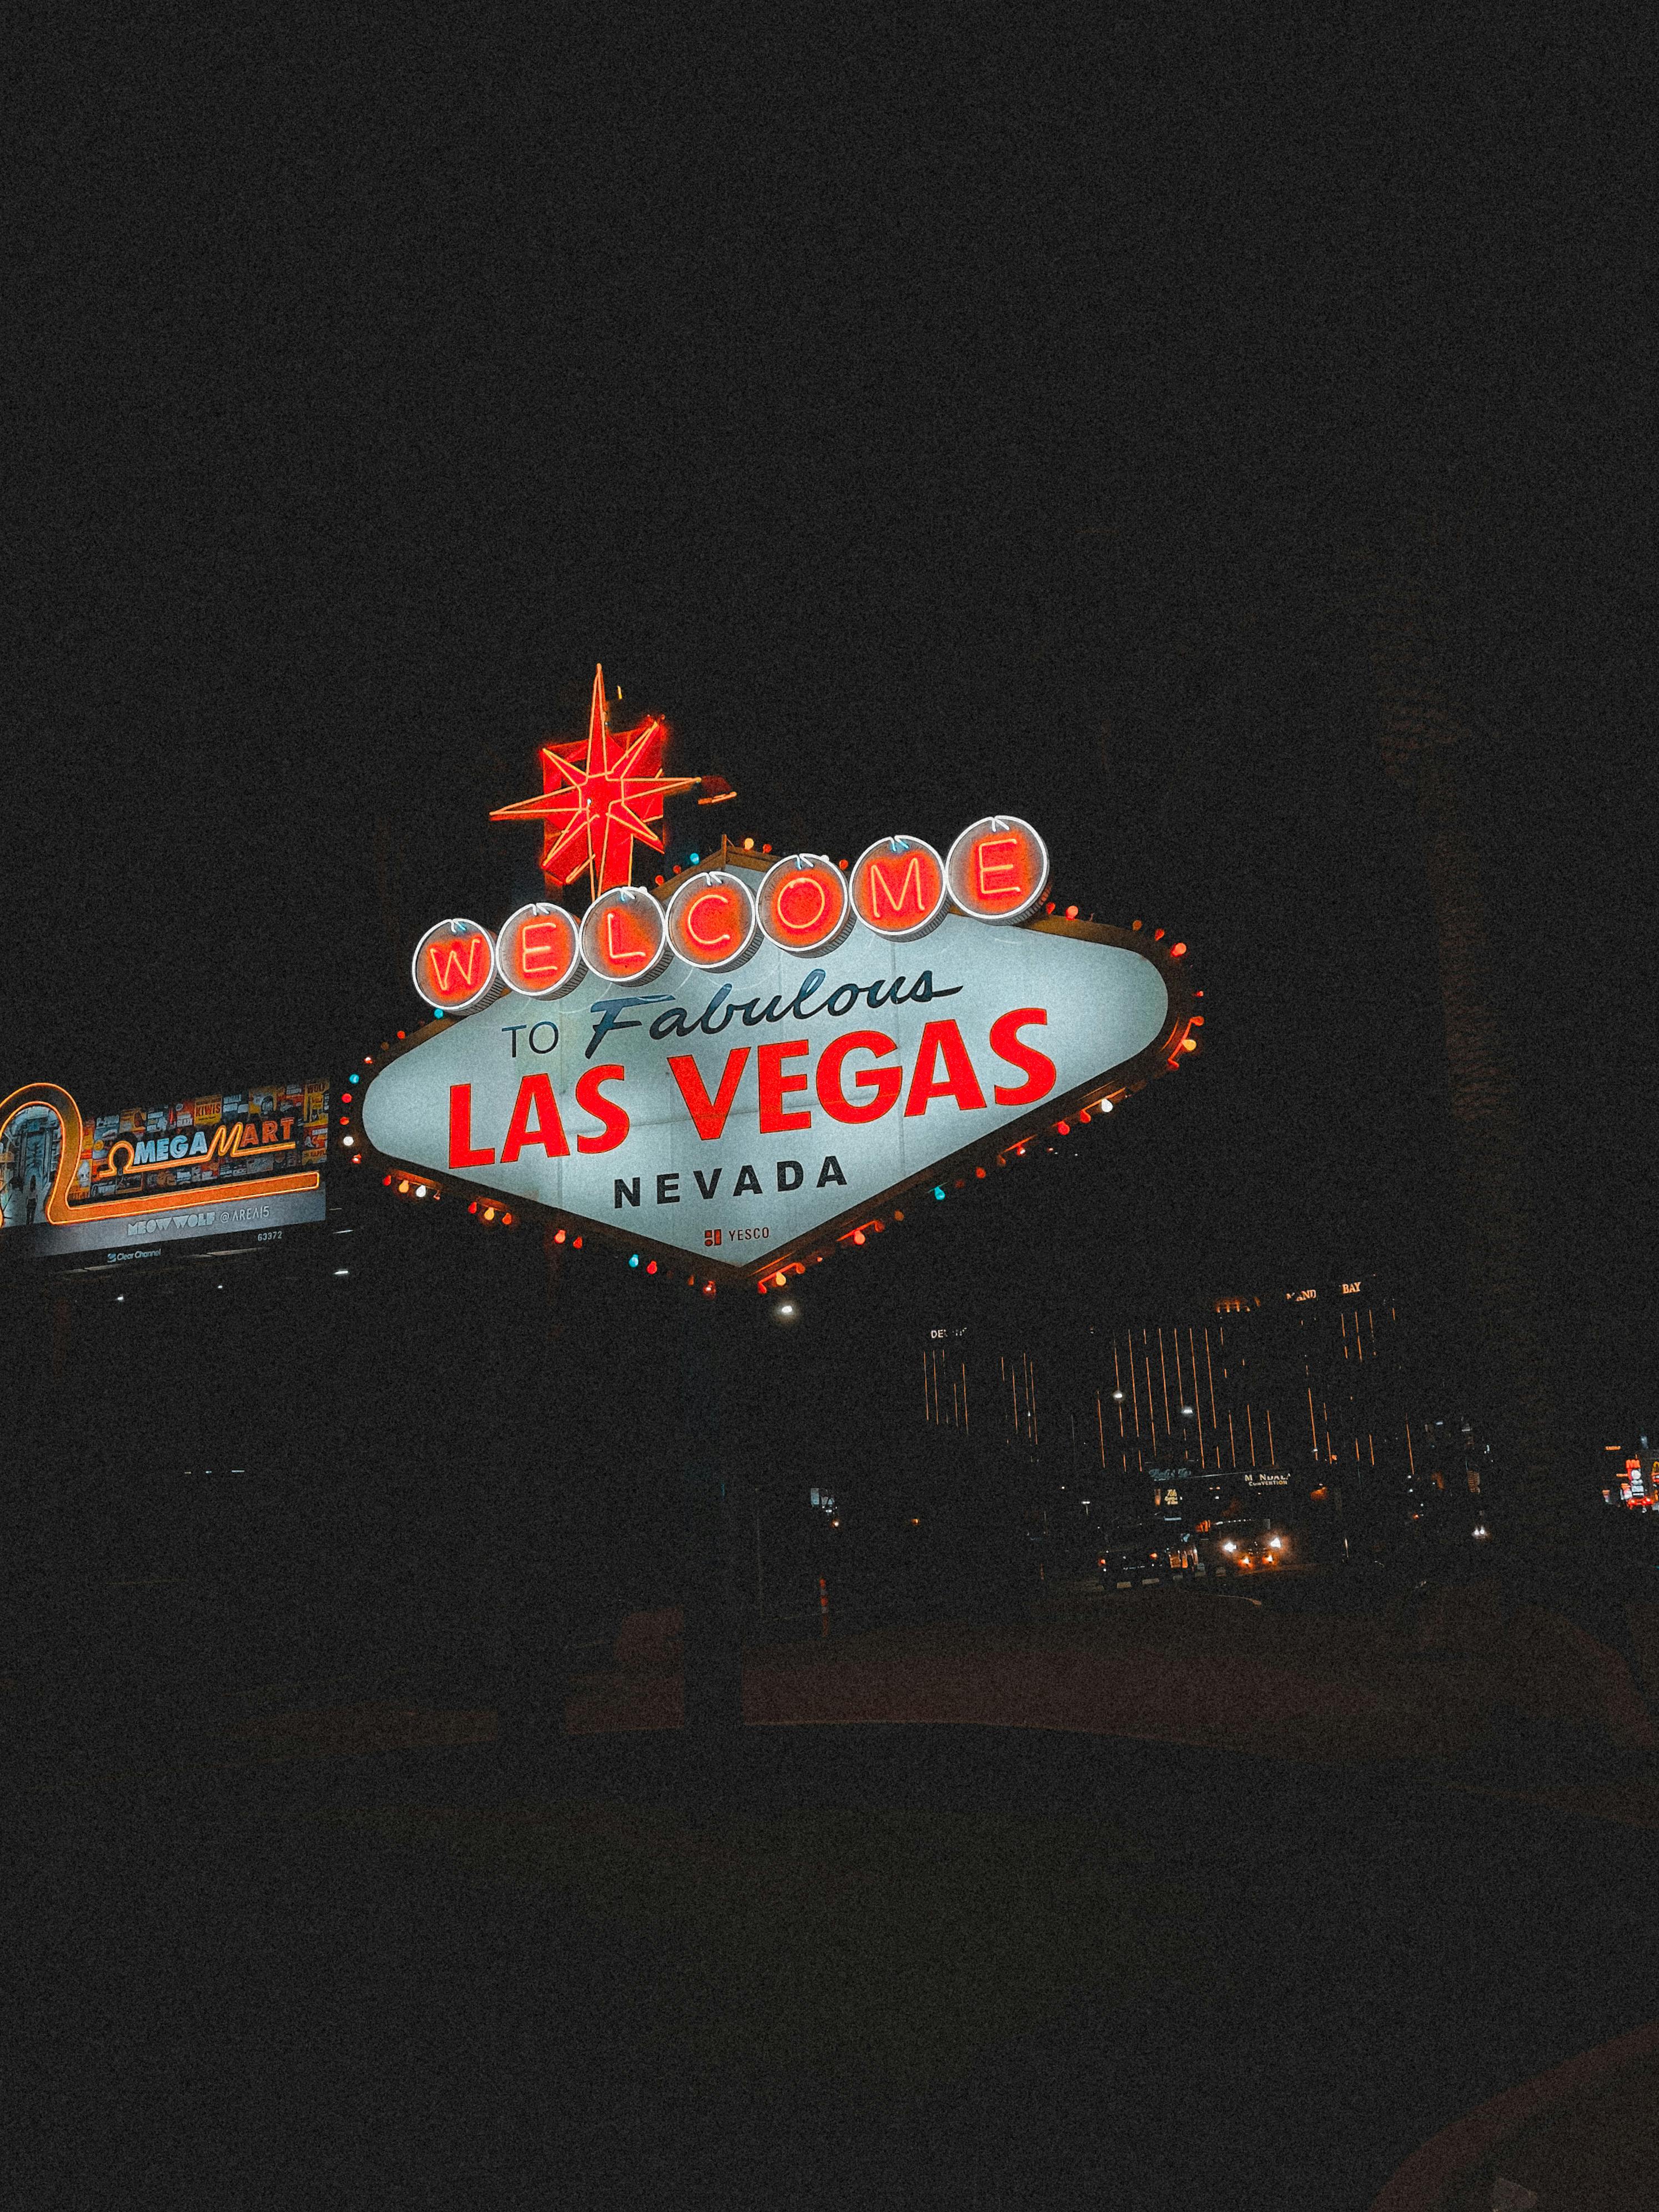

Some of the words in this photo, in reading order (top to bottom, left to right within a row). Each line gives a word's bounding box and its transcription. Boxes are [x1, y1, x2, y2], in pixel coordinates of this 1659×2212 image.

[429, 837, 1021, 992] WELCOME
[501, 1020, 558, 1058] TO
[584, 968, 964, 1060] Fabulous
[449, 1064, 630, 1170] LAS
[667, 1008, 1057, 1141] VEGAS
[614, 1155, 848, 1209] NEVADA
[117, 1251, 134, 1261] Clear
[135, 1248, 161, 1259] Channel
[728, 1226, 770, 1242] YESCO
[1342, 1281, 1361, 1294] BAY
